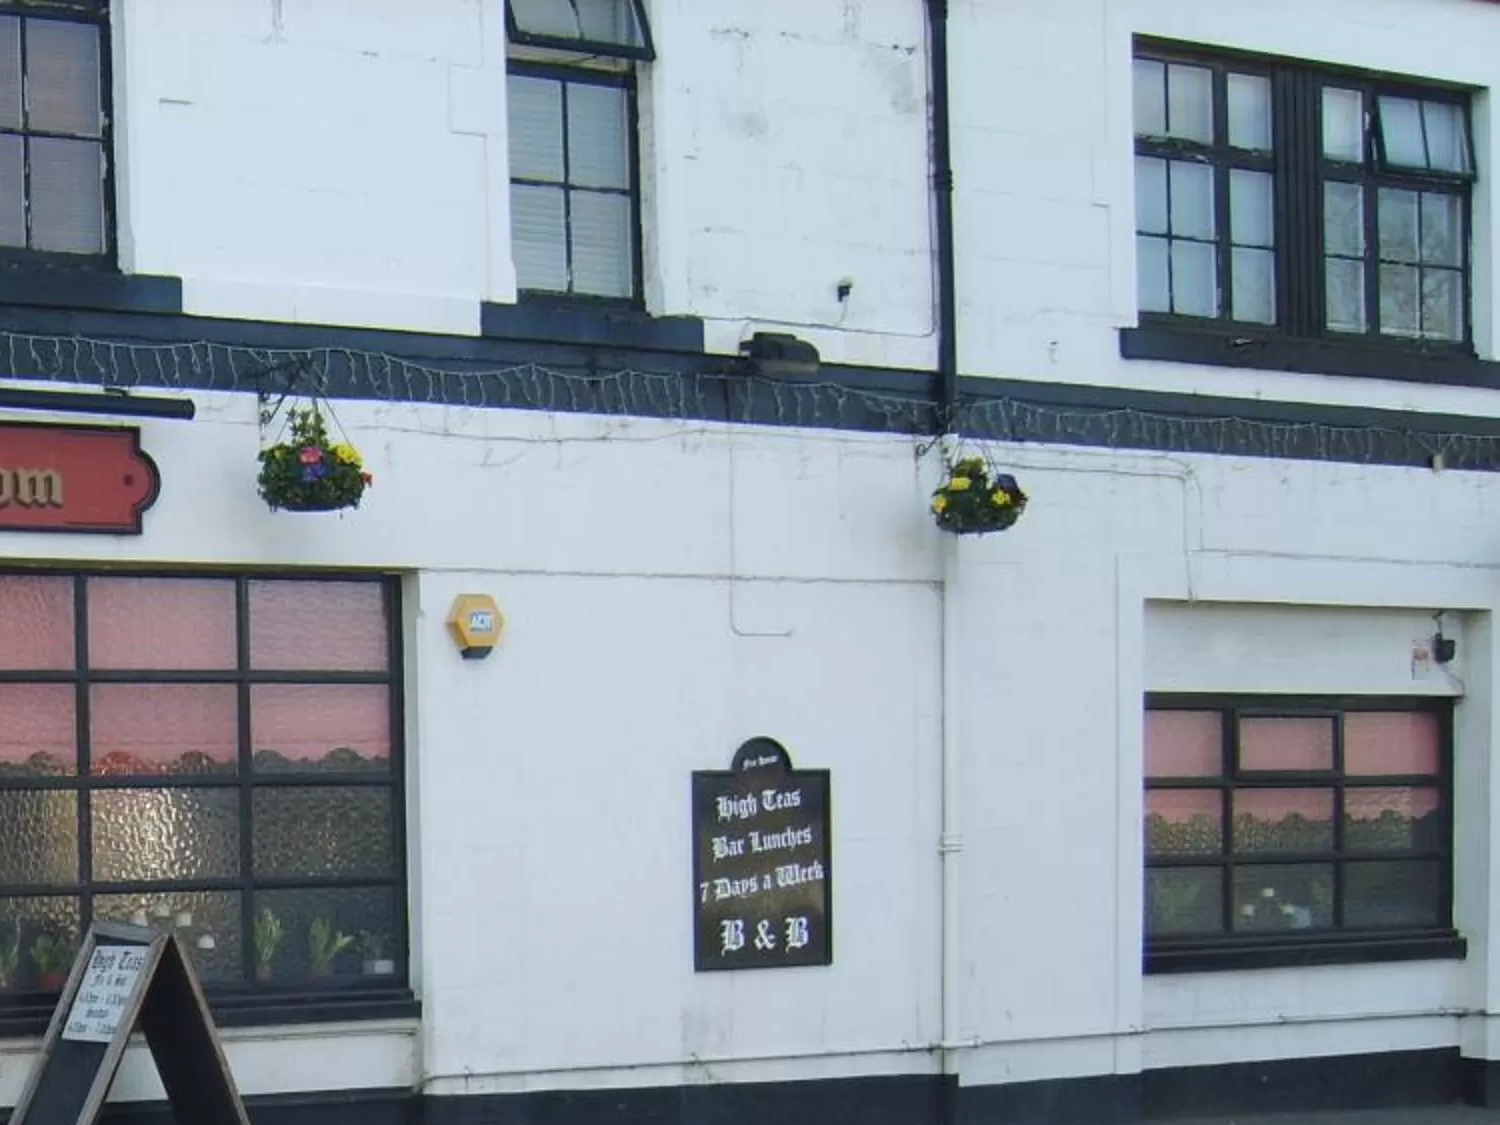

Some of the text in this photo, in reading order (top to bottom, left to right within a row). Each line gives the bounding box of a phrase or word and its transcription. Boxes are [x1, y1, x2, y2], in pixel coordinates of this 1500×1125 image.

[716, 788, 802, 824] High Teas
[711, 825, 813, 863] Bar Lunches
[699, 859, 825, 904] 7 Days a Week
[719, 916, 810, 957] B & B
